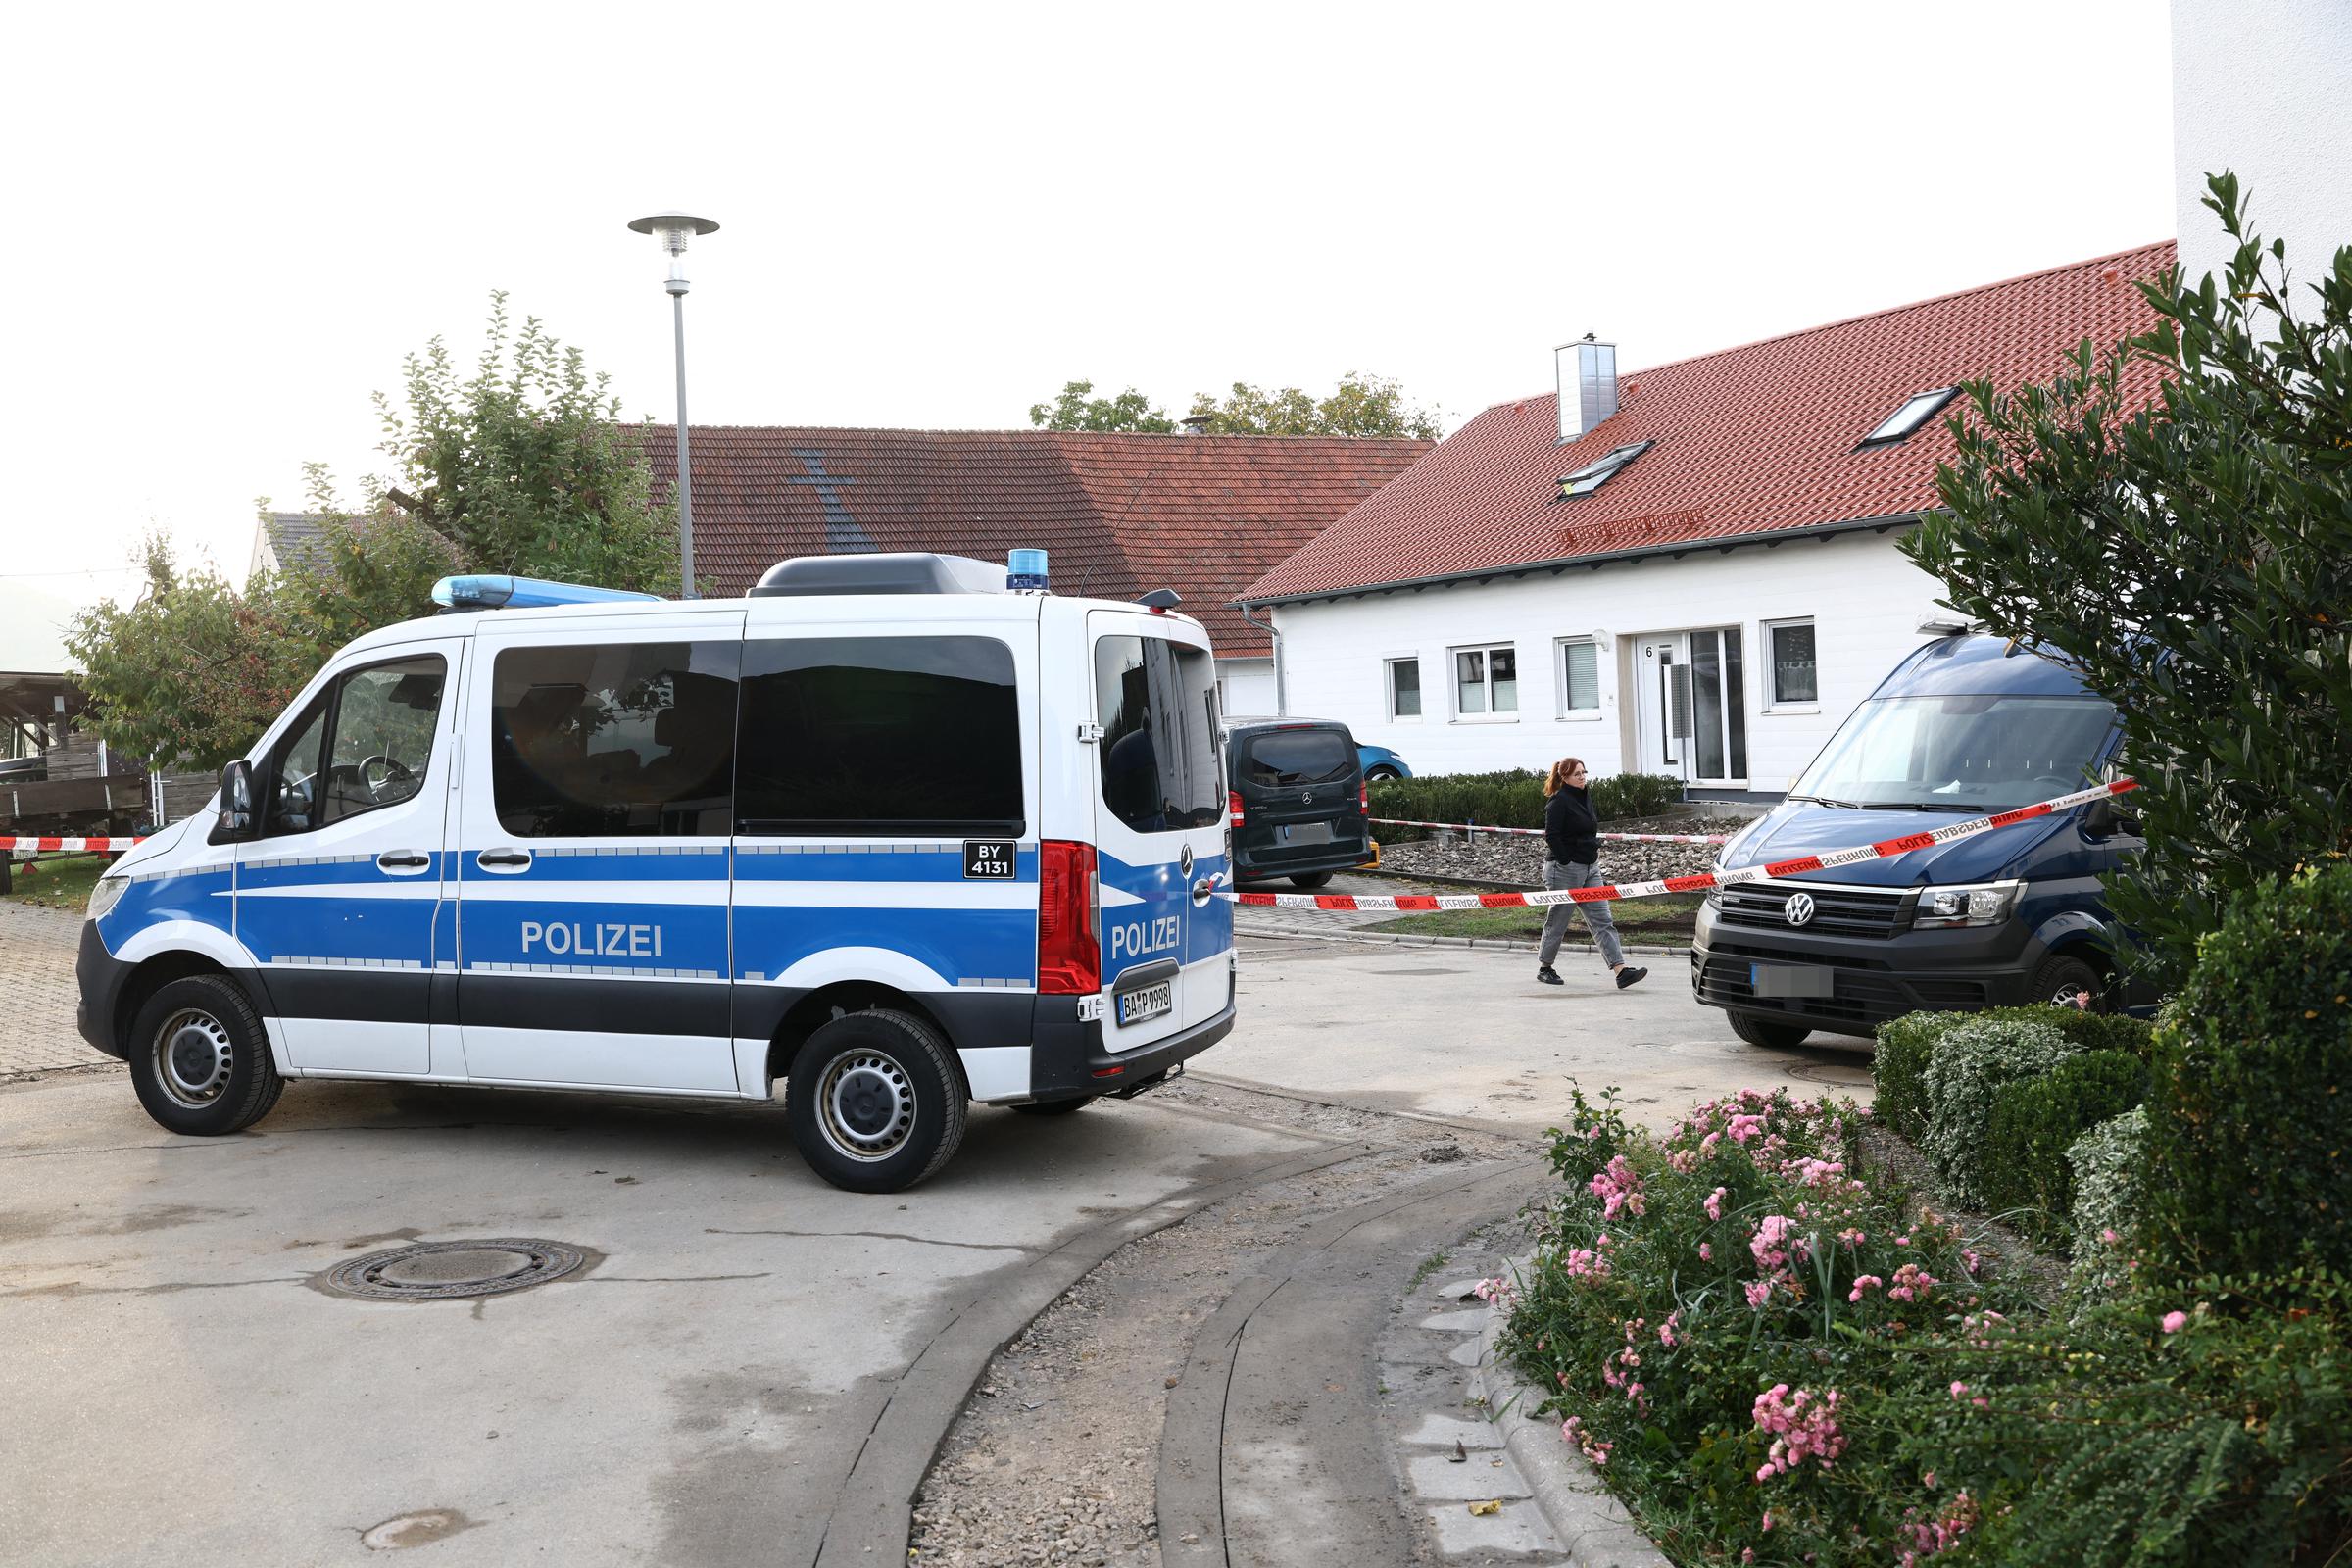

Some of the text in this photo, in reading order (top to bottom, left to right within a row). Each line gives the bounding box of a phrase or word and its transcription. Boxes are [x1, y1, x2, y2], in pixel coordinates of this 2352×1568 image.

[1645, 646, 1653, 658] 6
[979, 845, 1000, 858] BY
[971, 861, 1008, 875] 4131
[521, 921, 662, 957] POLIZEI
[1112, 915, 1180, 959] POLIZEI
[1124, 995, 1137, 1018] BA
[1142, 992, 1148, 1013] P
[1149, 986, 1169, 1011] 9998
